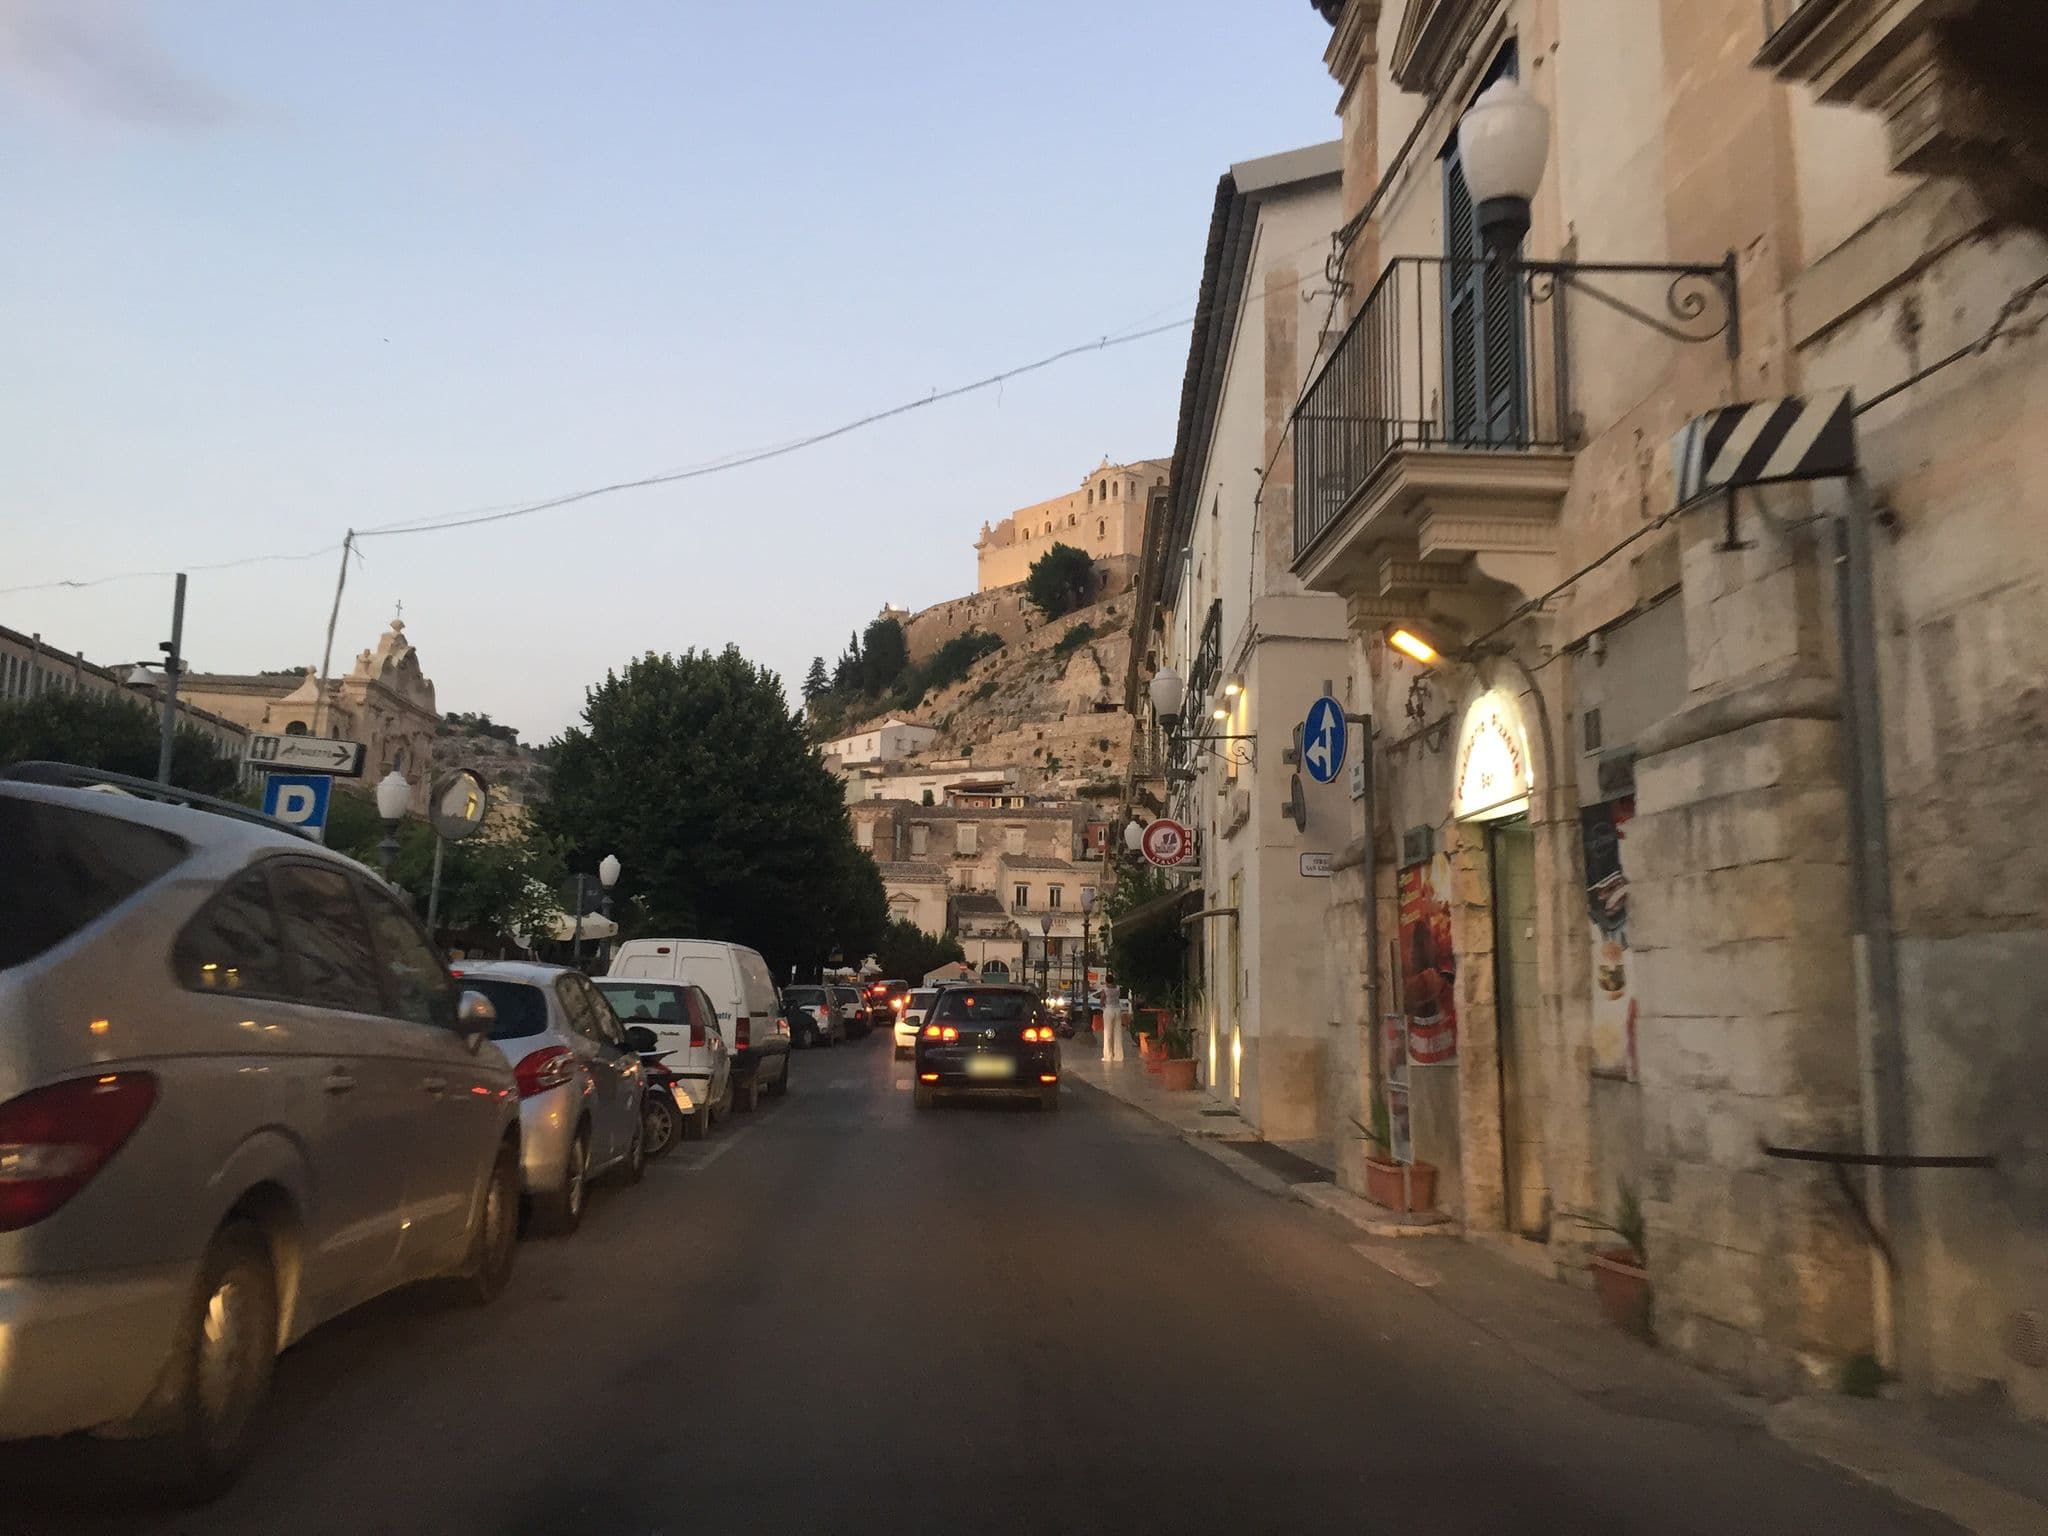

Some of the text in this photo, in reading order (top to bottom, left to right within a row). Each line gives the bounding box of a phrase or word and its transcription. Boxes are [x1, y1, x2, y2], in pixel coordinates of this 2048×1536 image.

[275, 785, 316, 823] P
[1184, 830, 1192, 856] BAR
[1152, 856, 1181, 865] ITALIA
